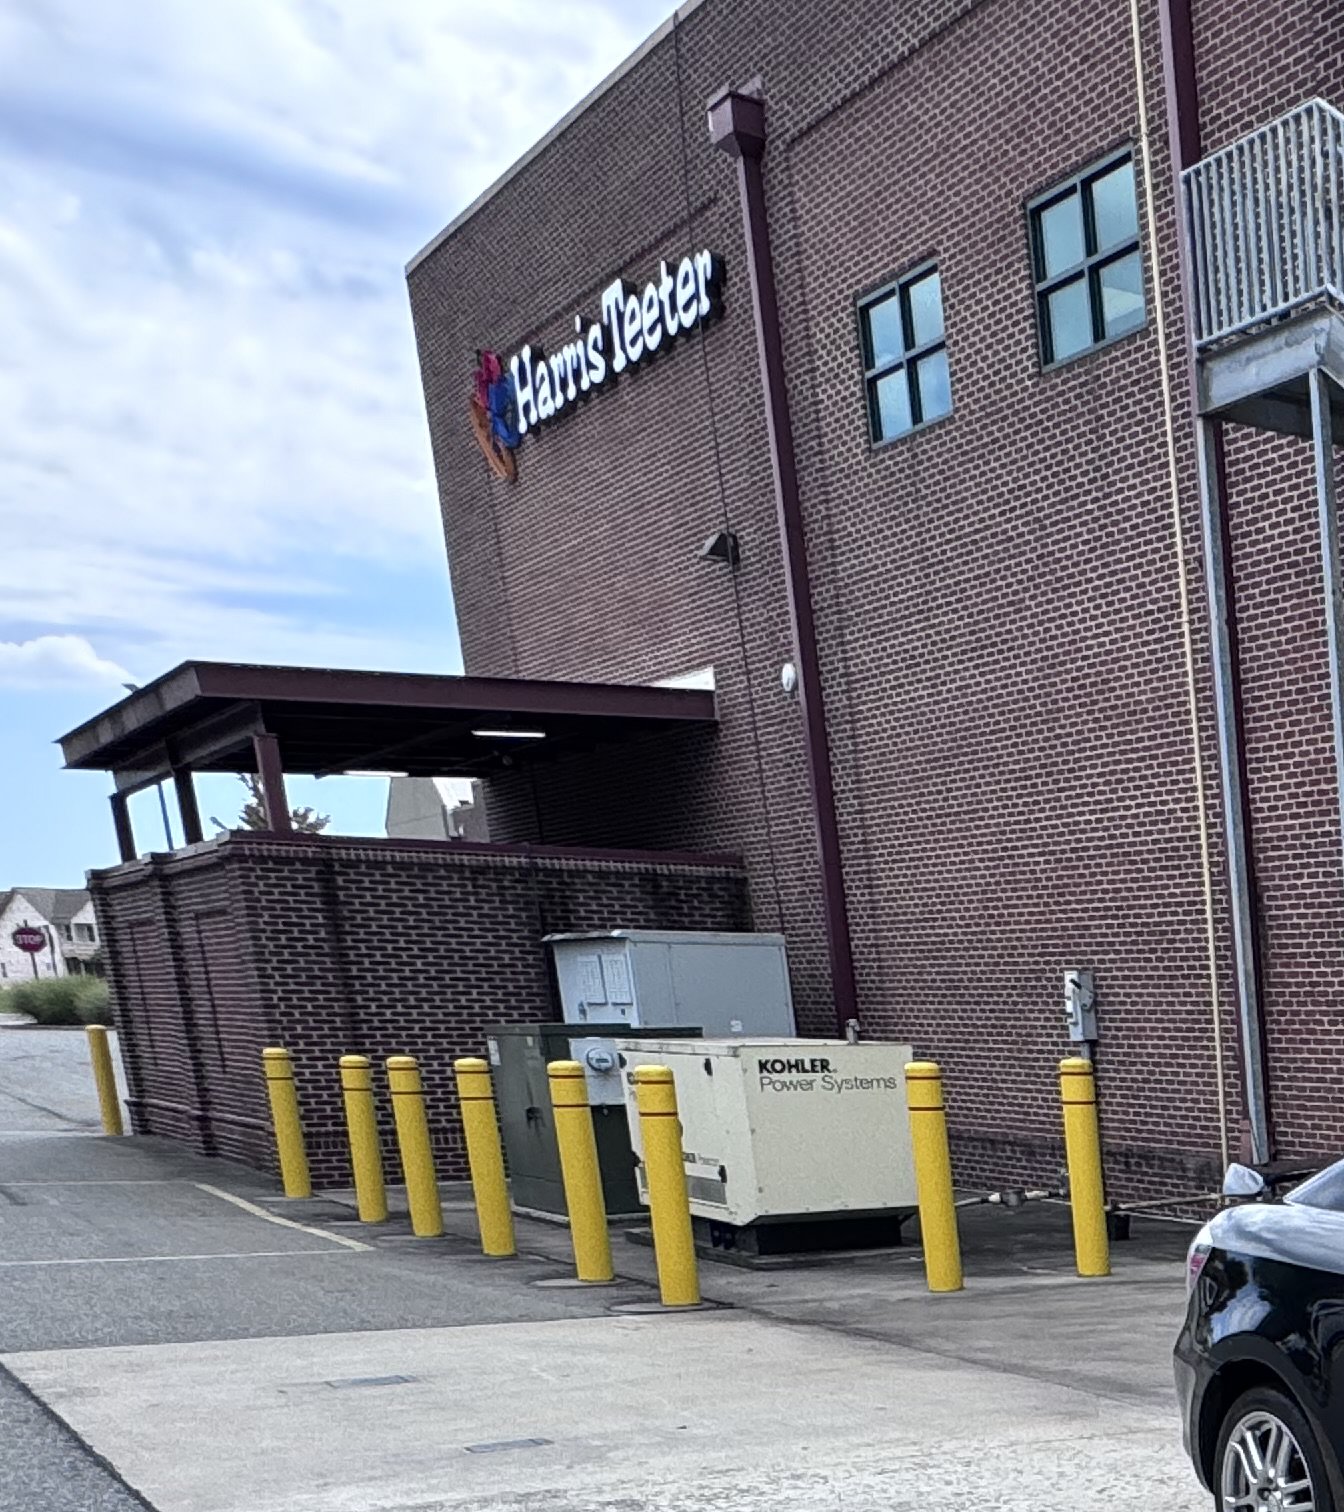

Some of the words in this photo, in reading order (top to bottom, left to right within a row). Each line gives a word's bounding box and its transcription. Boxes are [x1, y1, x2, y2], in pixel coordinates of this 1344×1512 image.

[510, 314, 606, 434] Harris
[601, 248, 713, 373] Teeter
[15, 934, 43, 945] STOP
[758, 1058, 832, 1074] KOHLER
[760, 1075, 817, 1092] Power
[821, 1074, 897, 1094] Systems
